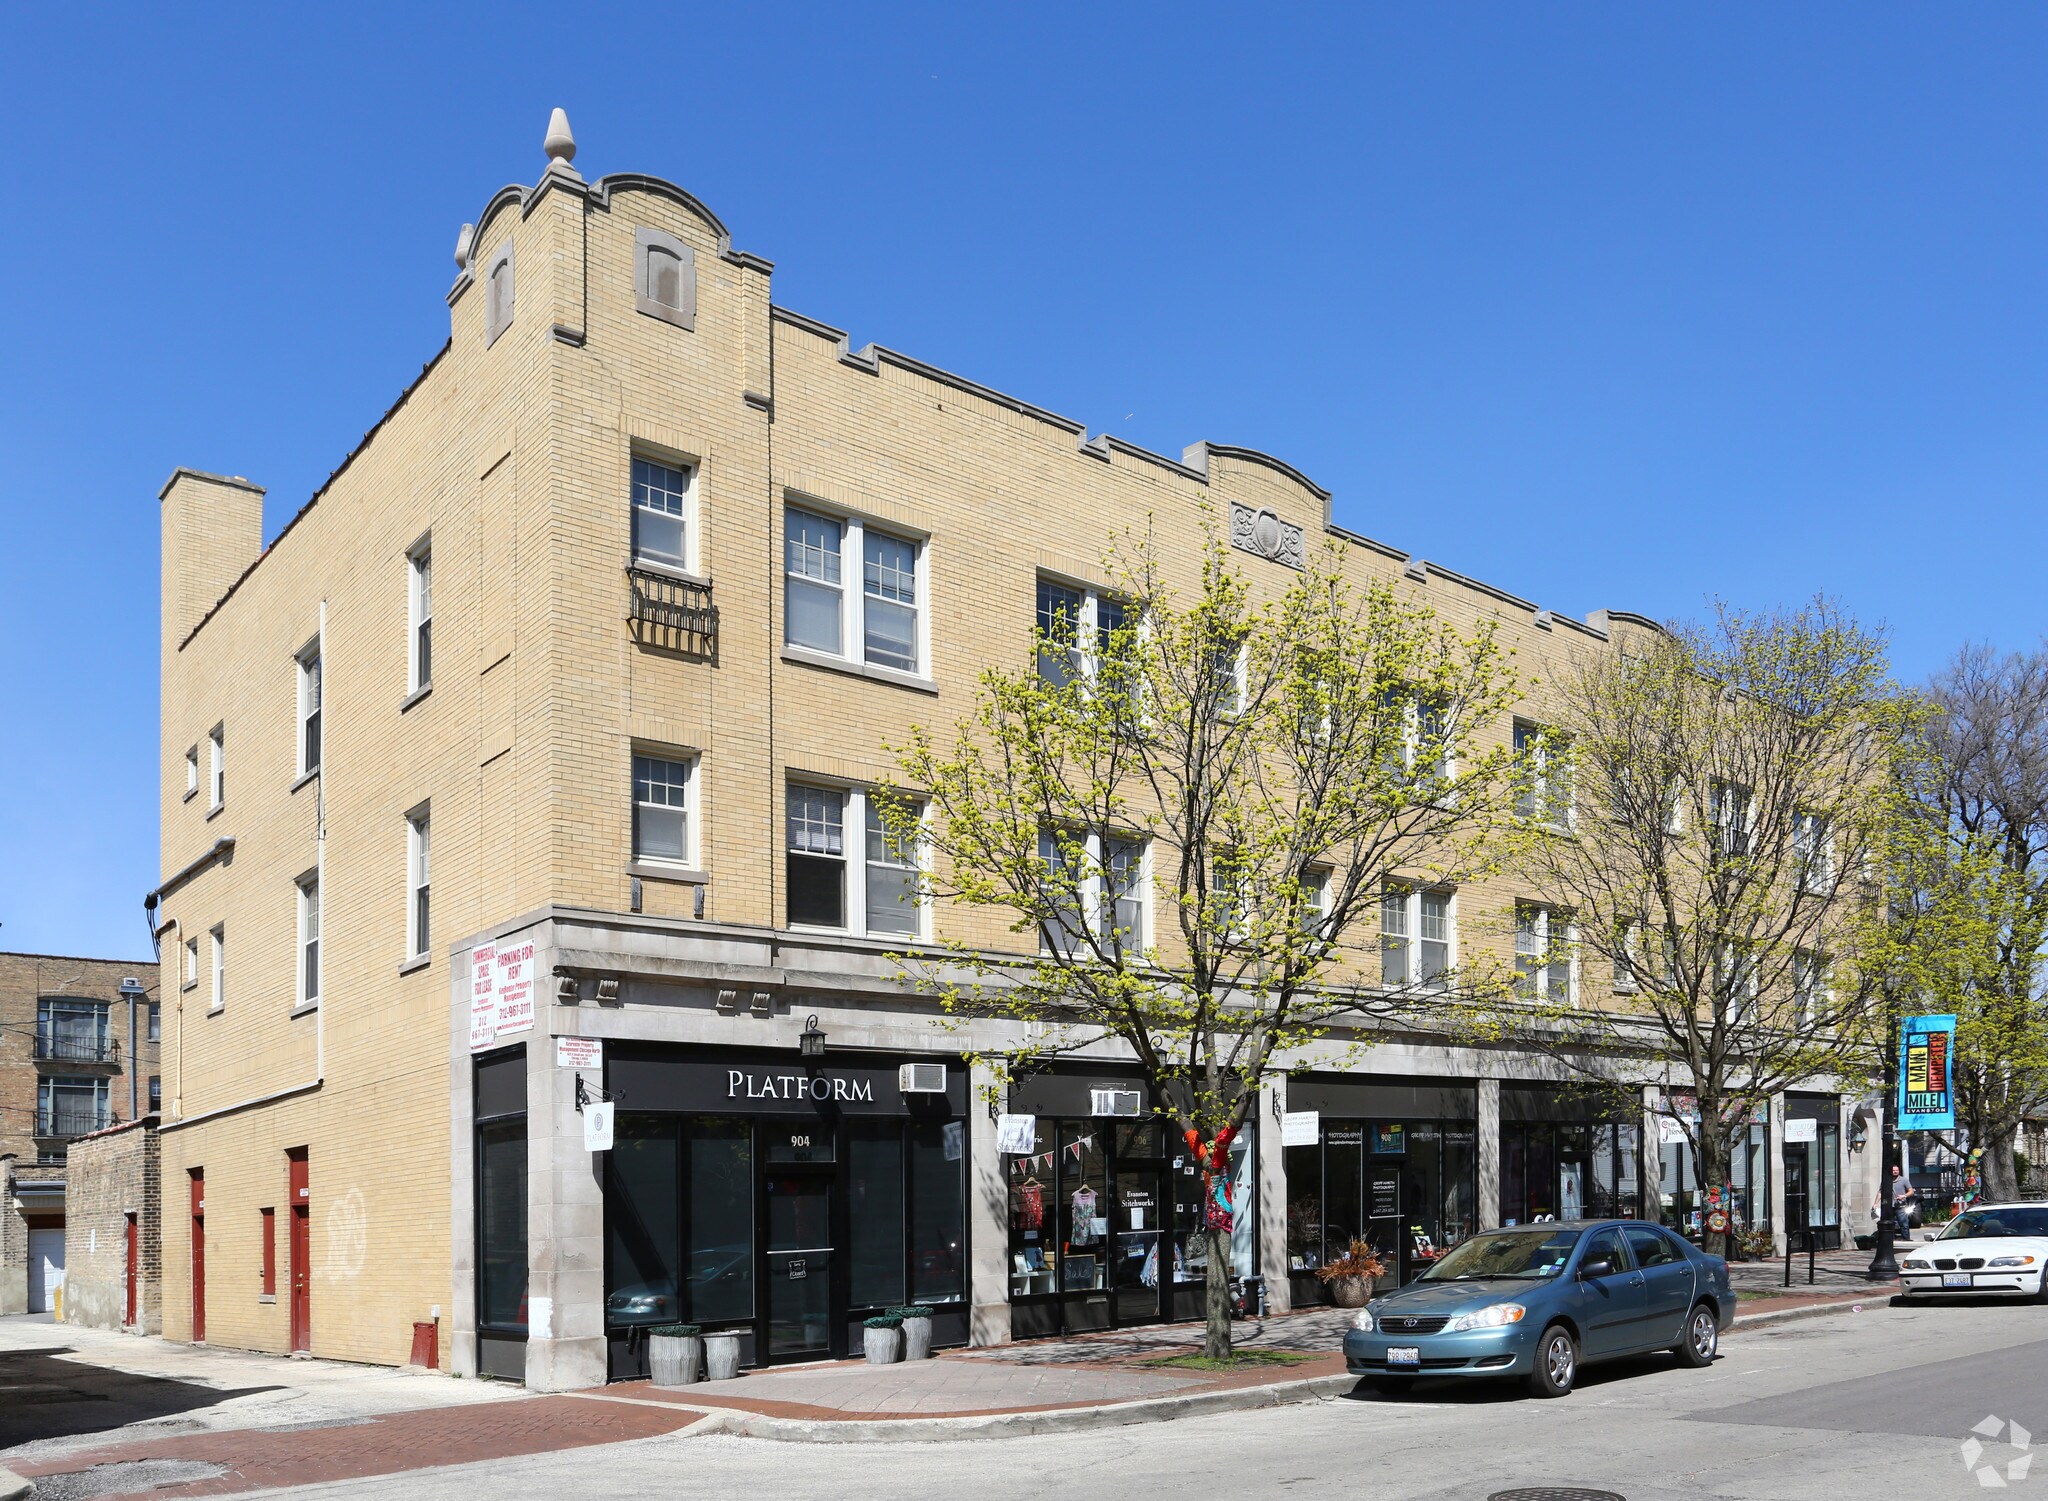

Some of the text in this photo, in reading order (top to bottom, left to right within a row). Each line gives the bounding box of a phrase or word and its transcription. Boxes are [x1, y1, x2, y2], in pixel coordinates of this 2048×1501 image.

[497, 945, 533, 968] PARKING FOR
[508, 964, 522, 980] RENT
[1908, 1093, 1937, 1108] MILE
[791, 1136, 810, 1147] 904
[1133, 1135, 1147, 1145] 906
[1121, 1199, 1154, 1208] Stitchworks
